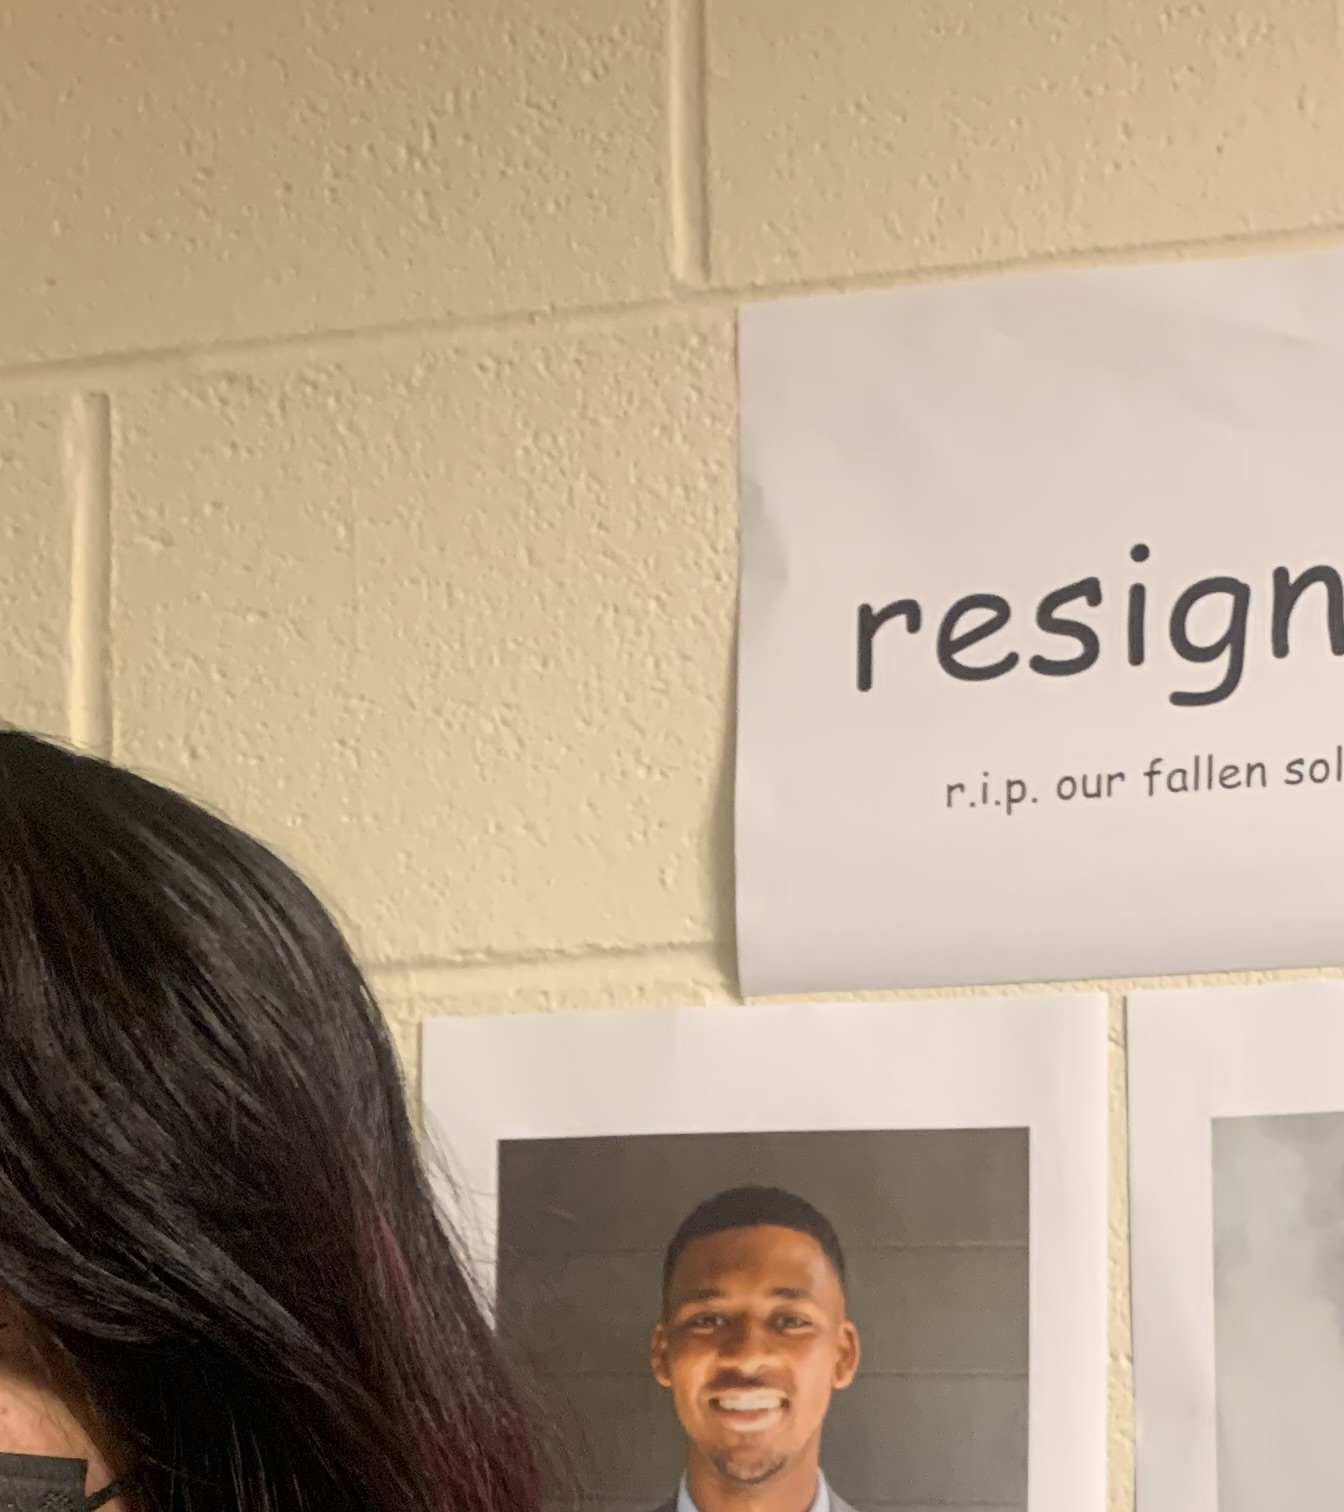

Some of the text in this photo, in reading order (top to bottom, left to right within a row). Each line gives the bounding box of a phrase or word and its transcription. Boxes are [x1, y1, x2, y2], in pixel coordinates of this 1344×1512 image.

[945, 771, 1039, 815] r.i.p.
[1055, 770, 1126, 801] our
[1144, 753, 1268, 798] fallen
